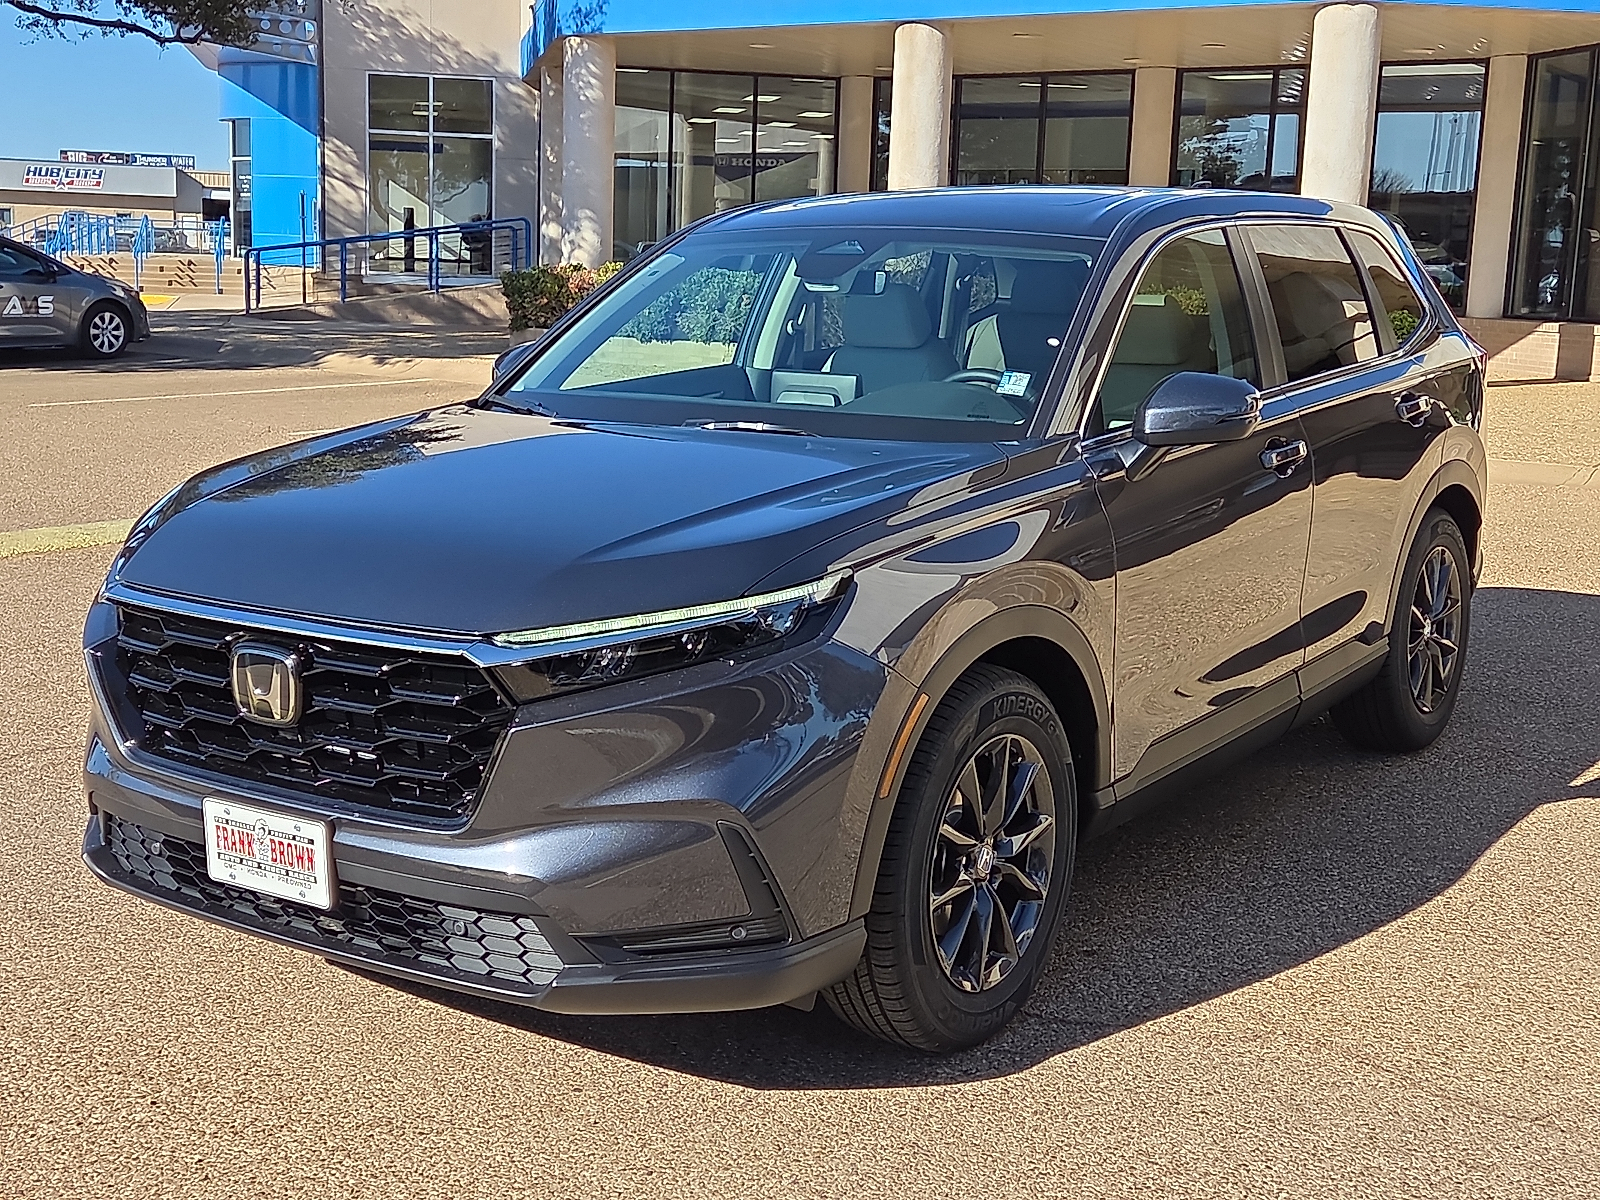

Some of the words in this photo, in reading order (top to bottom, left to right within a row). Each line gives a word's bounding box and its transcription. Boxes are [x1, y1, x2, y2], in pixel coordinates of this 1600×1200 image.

[171, 156, 194, 167] WATER
[731, 158, 786, 167] HONDA
[25, 166, 63, 178] HUB
[64, 168, 105, 180] CITY
[2, 294, 54, 315] AMS
[993, 695, 1050, 722] KINERGY
[216, 825, 256, 858] FRANK
[269, 838, 316, 874] BROWN
